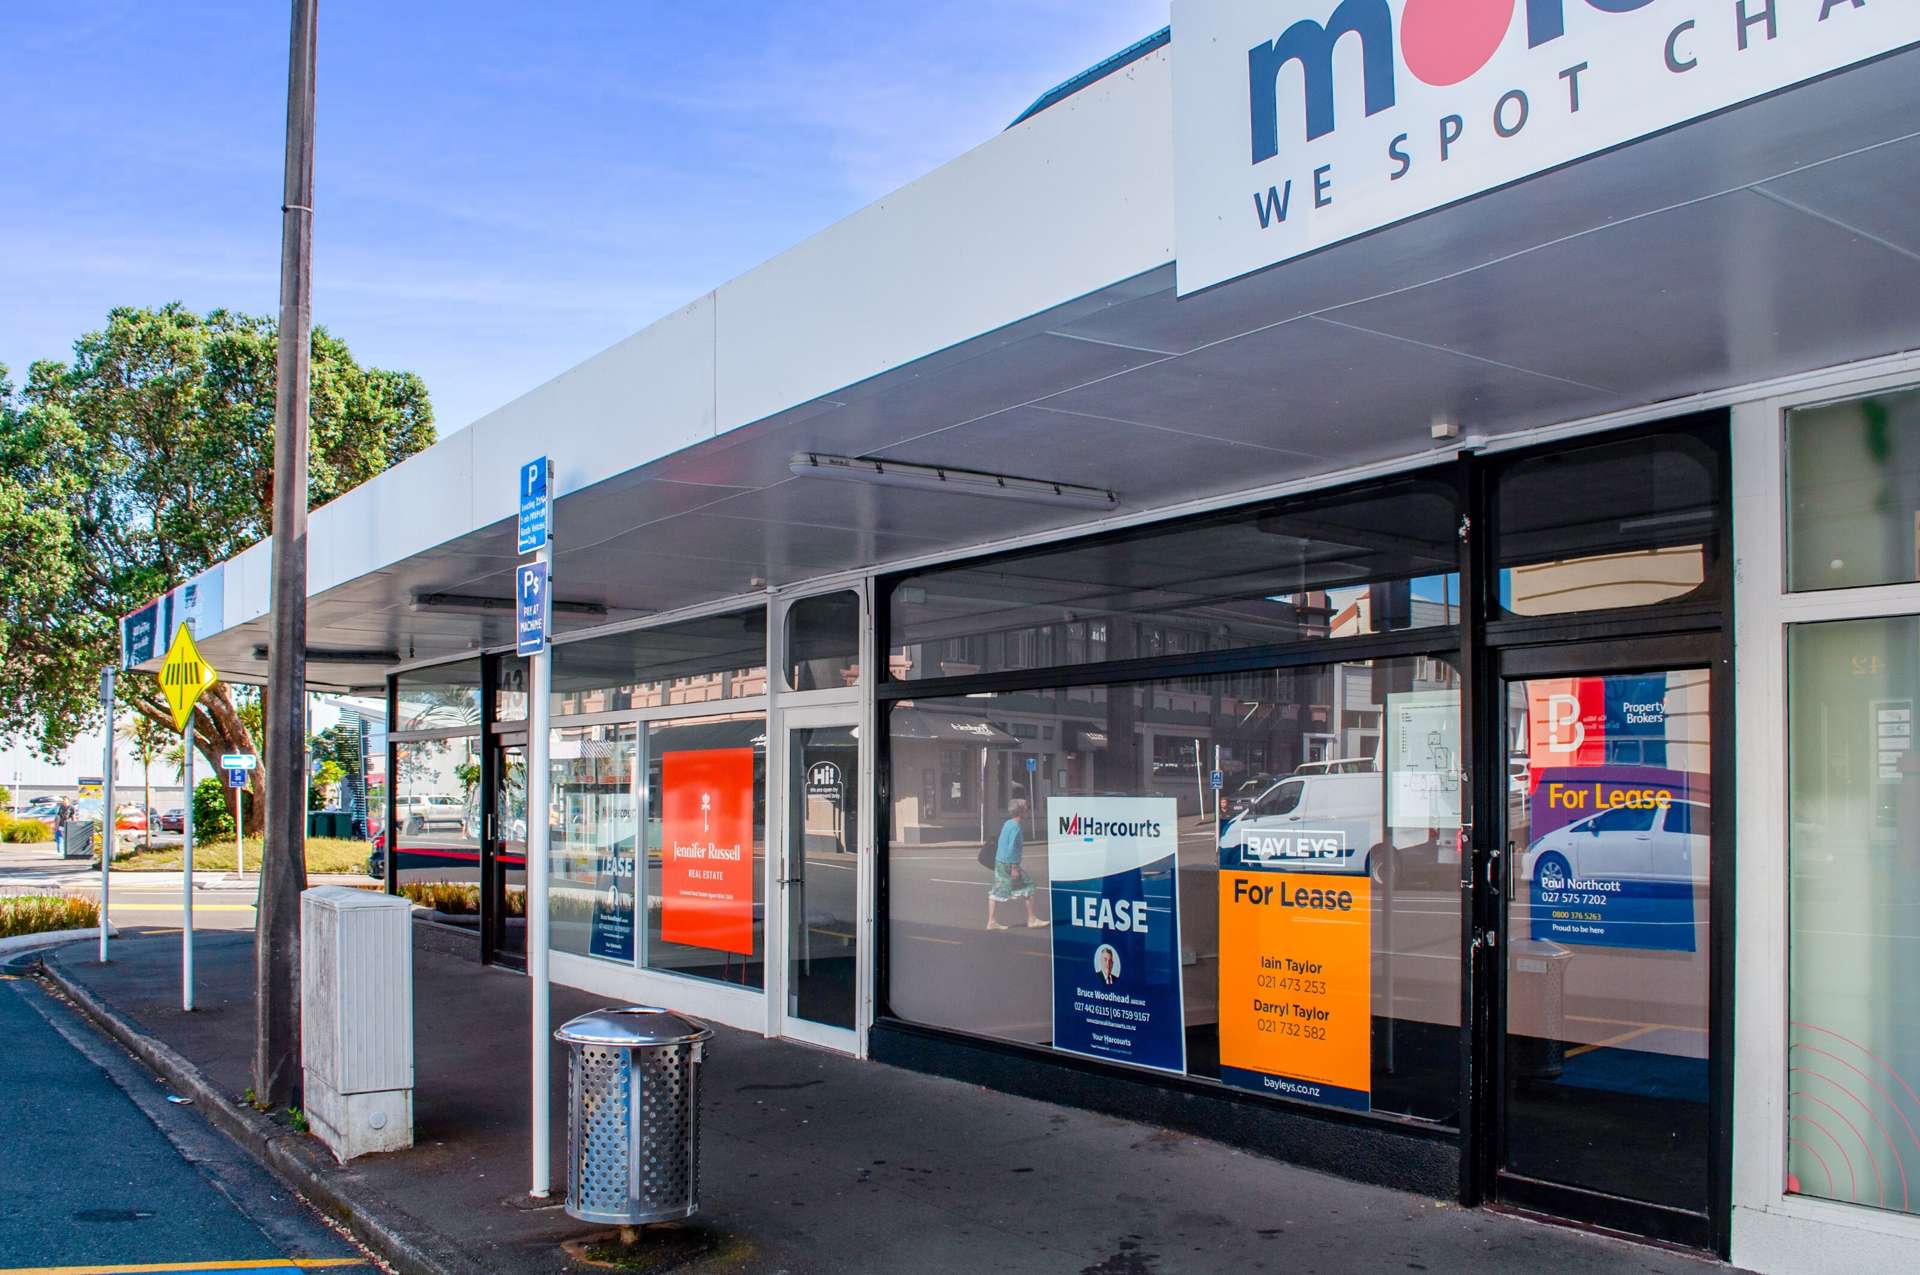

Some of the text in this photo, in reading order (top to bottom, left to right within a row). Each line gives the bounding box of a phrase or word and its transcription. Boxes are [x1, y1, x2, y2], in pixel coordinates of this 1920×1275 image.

[1253, 163, 1332, 230] WE
[1388, 61, 1588, 181] SPOT
[528, 464, 538, 496] P
[523, 603, 540, 617] PAY AT
[520, 618, 543, 633] MACHINE
[1623, 702, 1665, 714] Property
[1627, 713, 1663, 724] Brokers
[813, 765, 834, 785] Hi!
[1550, 783, 1672, 809] For Lease
[673, 841, 741, 862] Jennifer Russell
[1247, 836, 1339, 859] BAYLEYS
[602, 857, 633, 877] LEASE
[688, 868, 723, 881] REAL ESTATE
[1541, 877, 1621, 892] Paul Northcott
[1234, 878, 1353, 912] For Lease
[1542, 892, 1607, 905] 027 575 7202
[1071, 895, 1148, 933] LEASE
[1552, 910, 1602, 921] 0800 376 5263
[1552, 923, 1605, 934] Proud to be here
[1261, 955, 1323, 975] Iain Taylor
[1257, 974, 1327, 995] 021 473 253
[1077, 987, 1095, 998] Bruce
[1094, 990, 1130, 1004] Woodhead
[1074, 1001, 1085, 1012] 027
[1084, 1003, 1095, 1014] 442
[1095, 1005, 1110, 1017] 6115
[1112, 1008, 1122, 1018] 06
[1122, 1010, 1134, 1020] 759
[1134, 1012, 1151, 1022] 9167
[1253, 998, 1330, 1021] Darryl Taylor
[1092, 1032, 1132, 1047] Your Harcourts
[1257, 1018, 1327, 1041] 021 732 582
[1263, 1075, 1320, 1097] bayleys.co.nz
